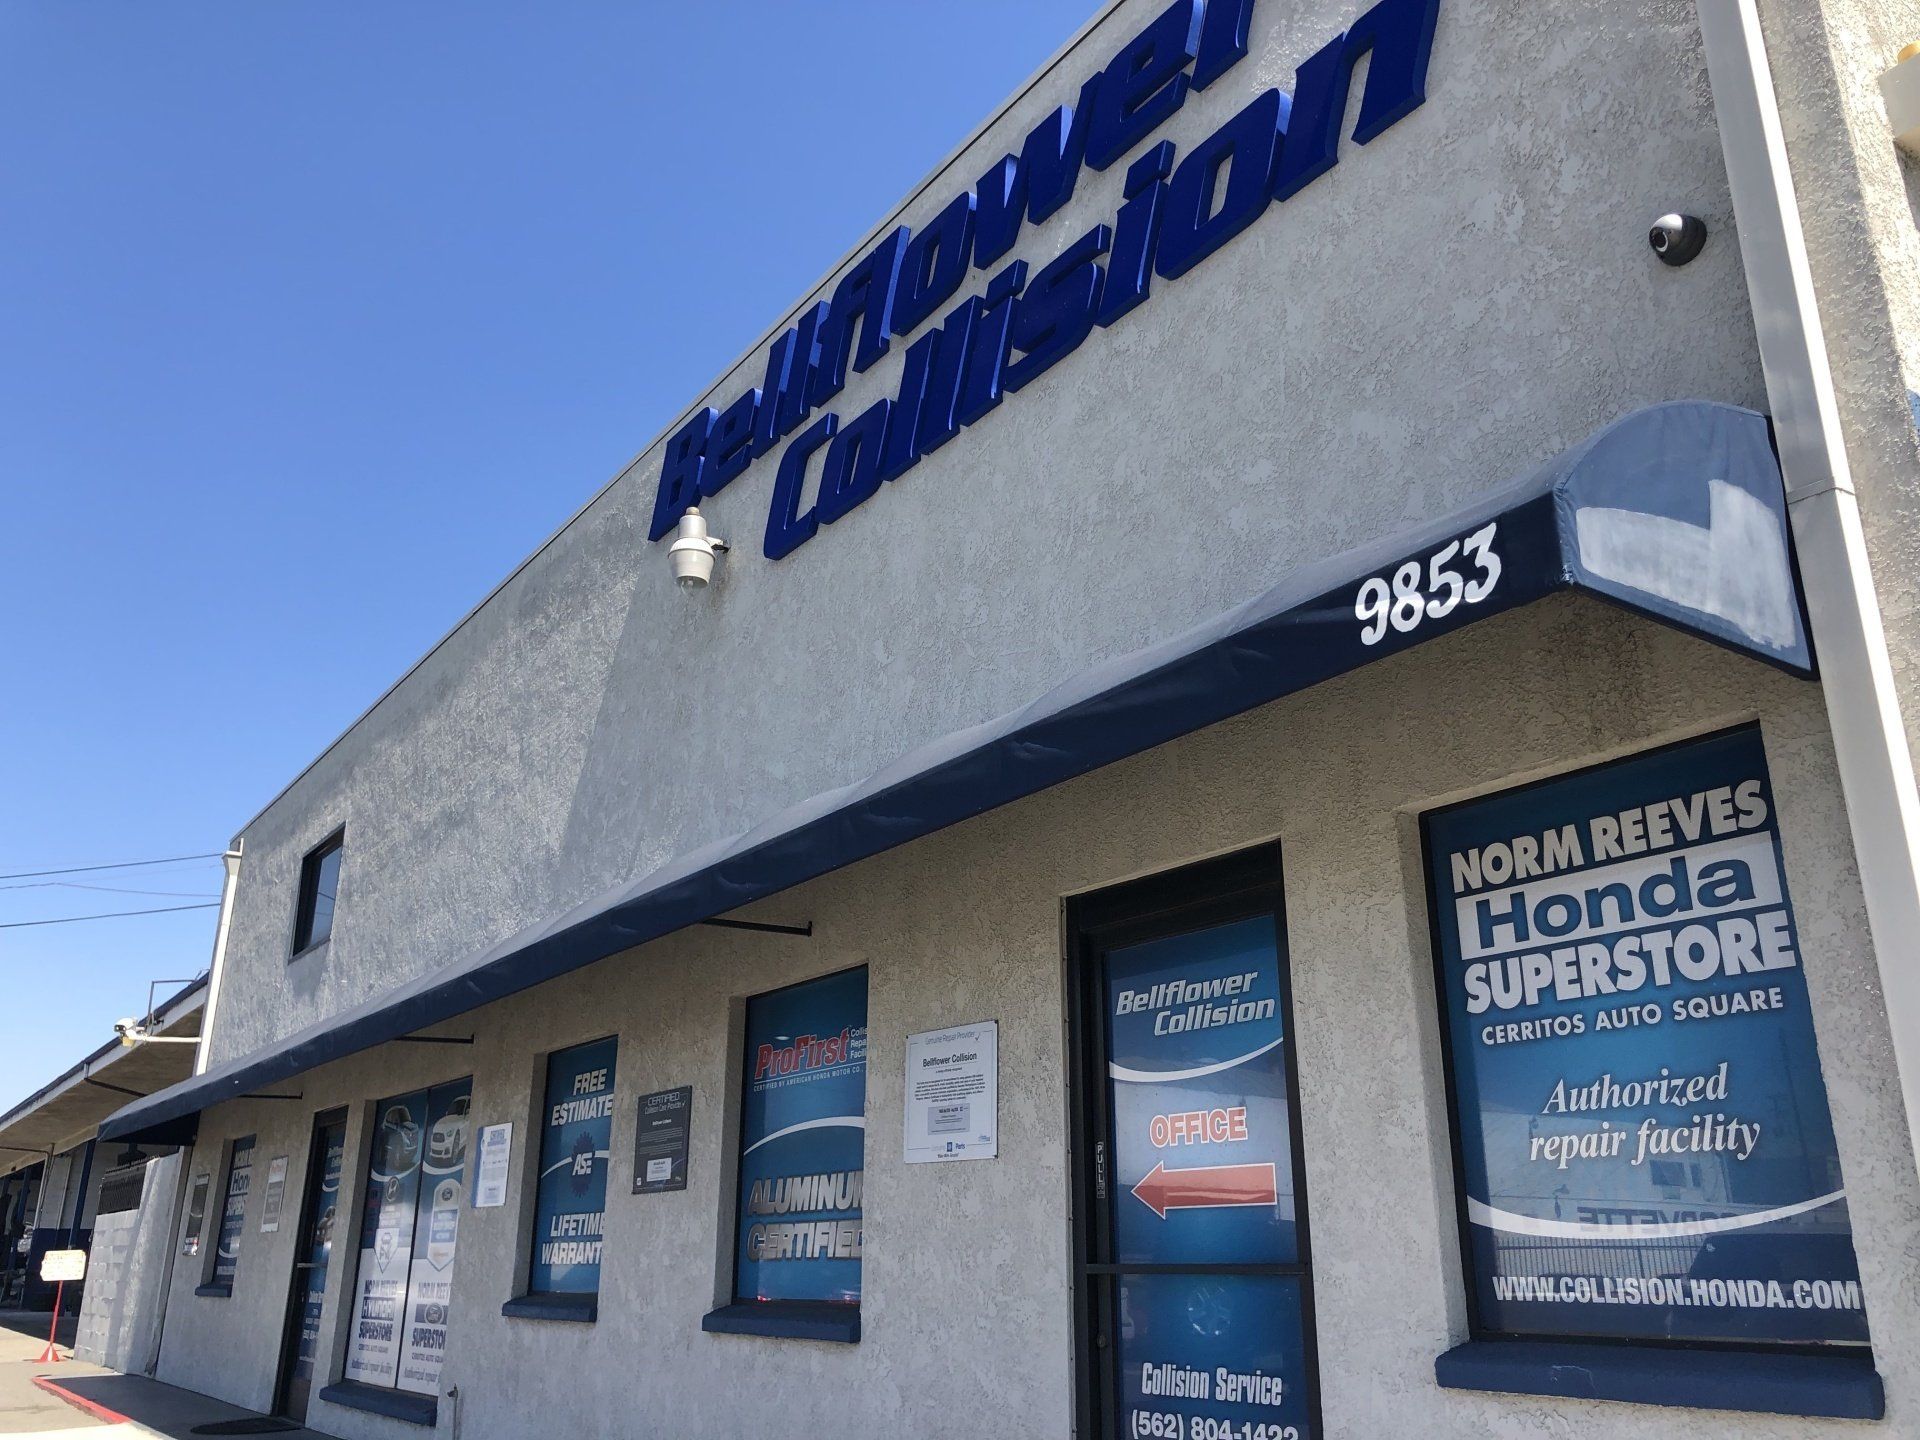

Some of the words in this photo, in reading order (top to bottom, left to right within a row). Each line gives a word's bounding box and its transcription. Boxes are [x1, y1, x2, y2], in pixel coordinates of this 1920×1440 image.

[763, 0, 1440, 560] Collision
[1355, 522, 1502, 646] 9853
[1451, 824, 1581, 893] NORM
[1590, 780, 1769, 861] REEVES
[1474, 855, 1758, 956] Honda
[1463, 910, 1797, 1014] SUPERSTORE
[1115, 969, 1259, 1016] Bellflower
[1153, 997, 1276, 1037] Collision
[1481, 1014, 1586, 1046] CERRITOS
[1595, 1002, 1662, 1032] AUTO
[1673, 987, 1784, 1022] SQUARE
[754, 1028, 850, 1080] ProFirst
[922, 1056, 951, 1068] Bellflower
[951, 1052, 978, 1063] Collision
[573, 1068, 607, 1096] FREE
[786, 1076, 812, 1086] AMERICAN
[813, 1072, 831, 1081] HONDA
[832, 1068, 850, 1077] MOTOR
[1541, 1062, 1729, 1115] Authorized
[1149, 1106, 1248, 1148] OFFICE
[1529, 1120, 1627, 1169] repair
[1631, 1112, 1761, 1168] facility
[572, 1152, 593, 1176] ASE
[1492, 1276, 1862, 1310] WWW.COLLISION.HONDA.COM
[359, 1321, 393, 1341] SUPERSTORE
[1141, 1362, 1210, 1400] Collision
[1215, 1367, 1283, 1406] Service
[1131, 1409, 1185, 1440] (562)
